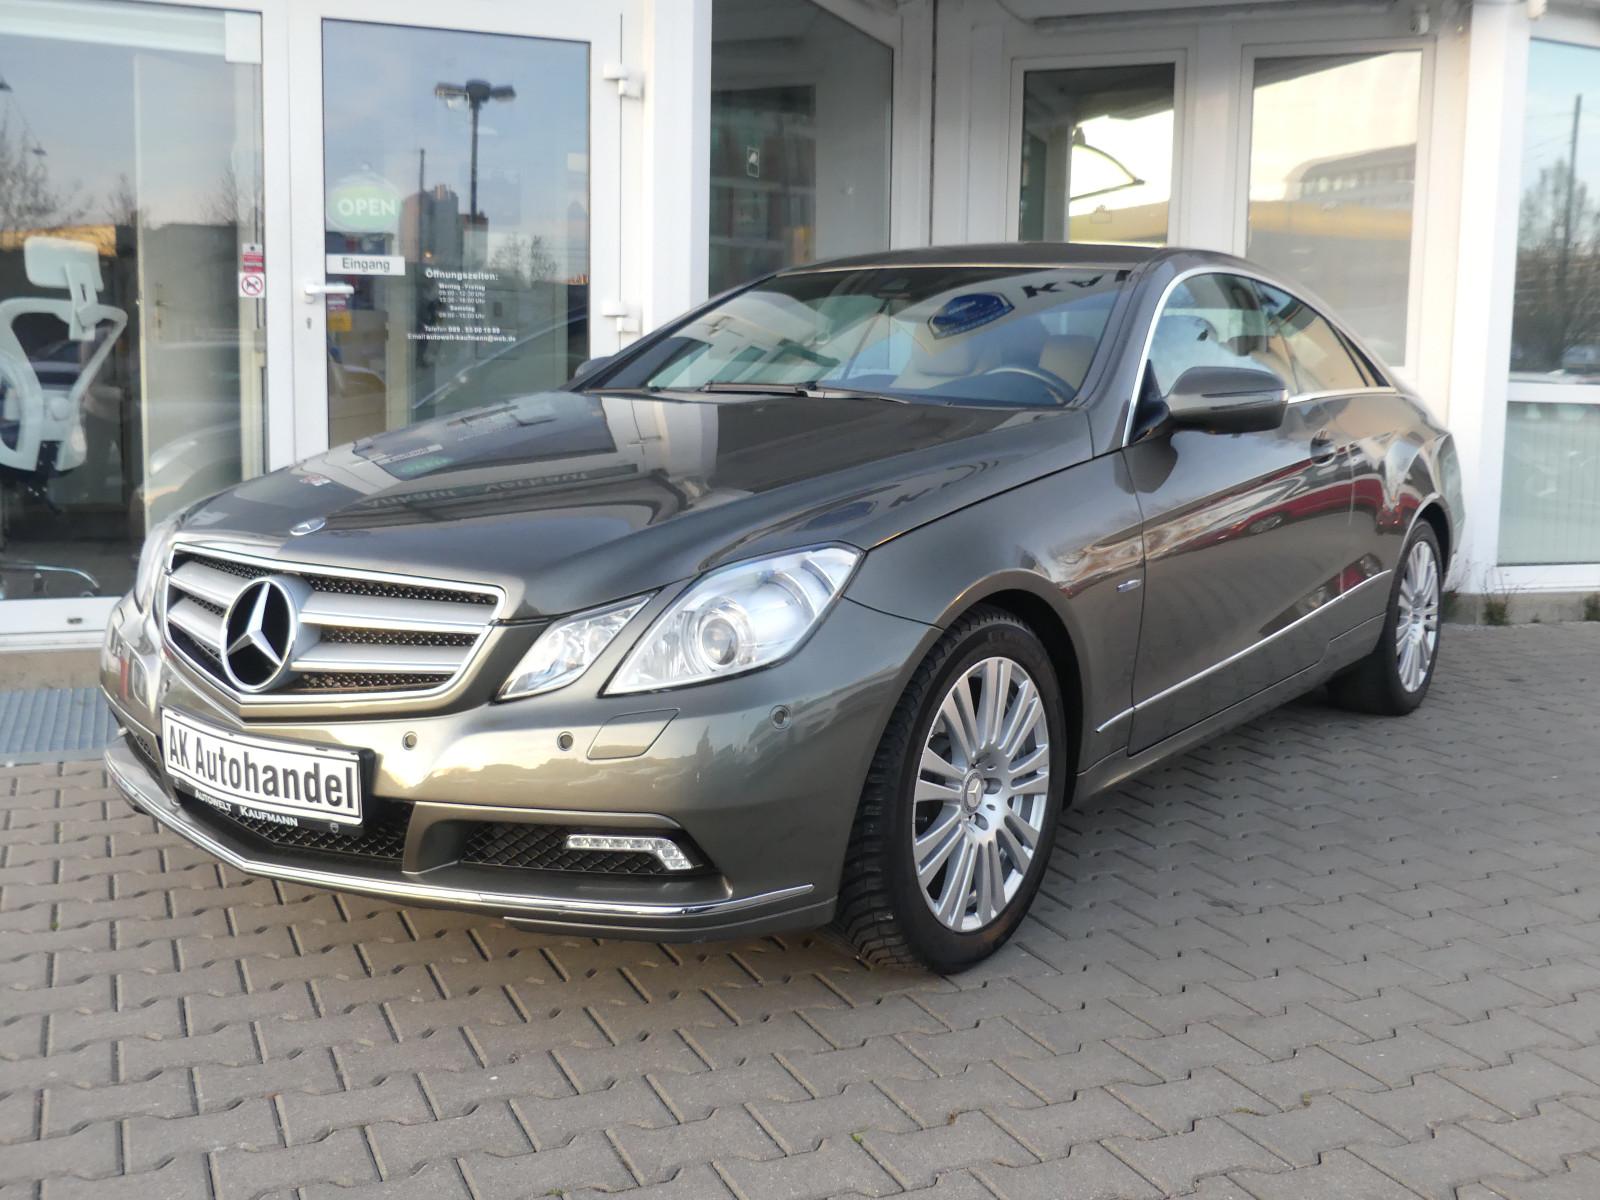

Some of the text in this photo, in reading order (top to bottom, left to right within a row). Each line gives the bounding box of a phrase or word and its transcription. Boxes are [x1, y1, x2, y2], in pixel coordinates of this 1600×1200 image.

[338, 198, 396, 217] OPEN
[342, 257, 390, 272] Eingang
[424, 267, 498, 281] Öffnungszeiten:
[449, 304, 475, 313] Samstag
[169, 725, 354, 809] AK Autohandel
[239, 805, 298, 827] KAUFMANN
